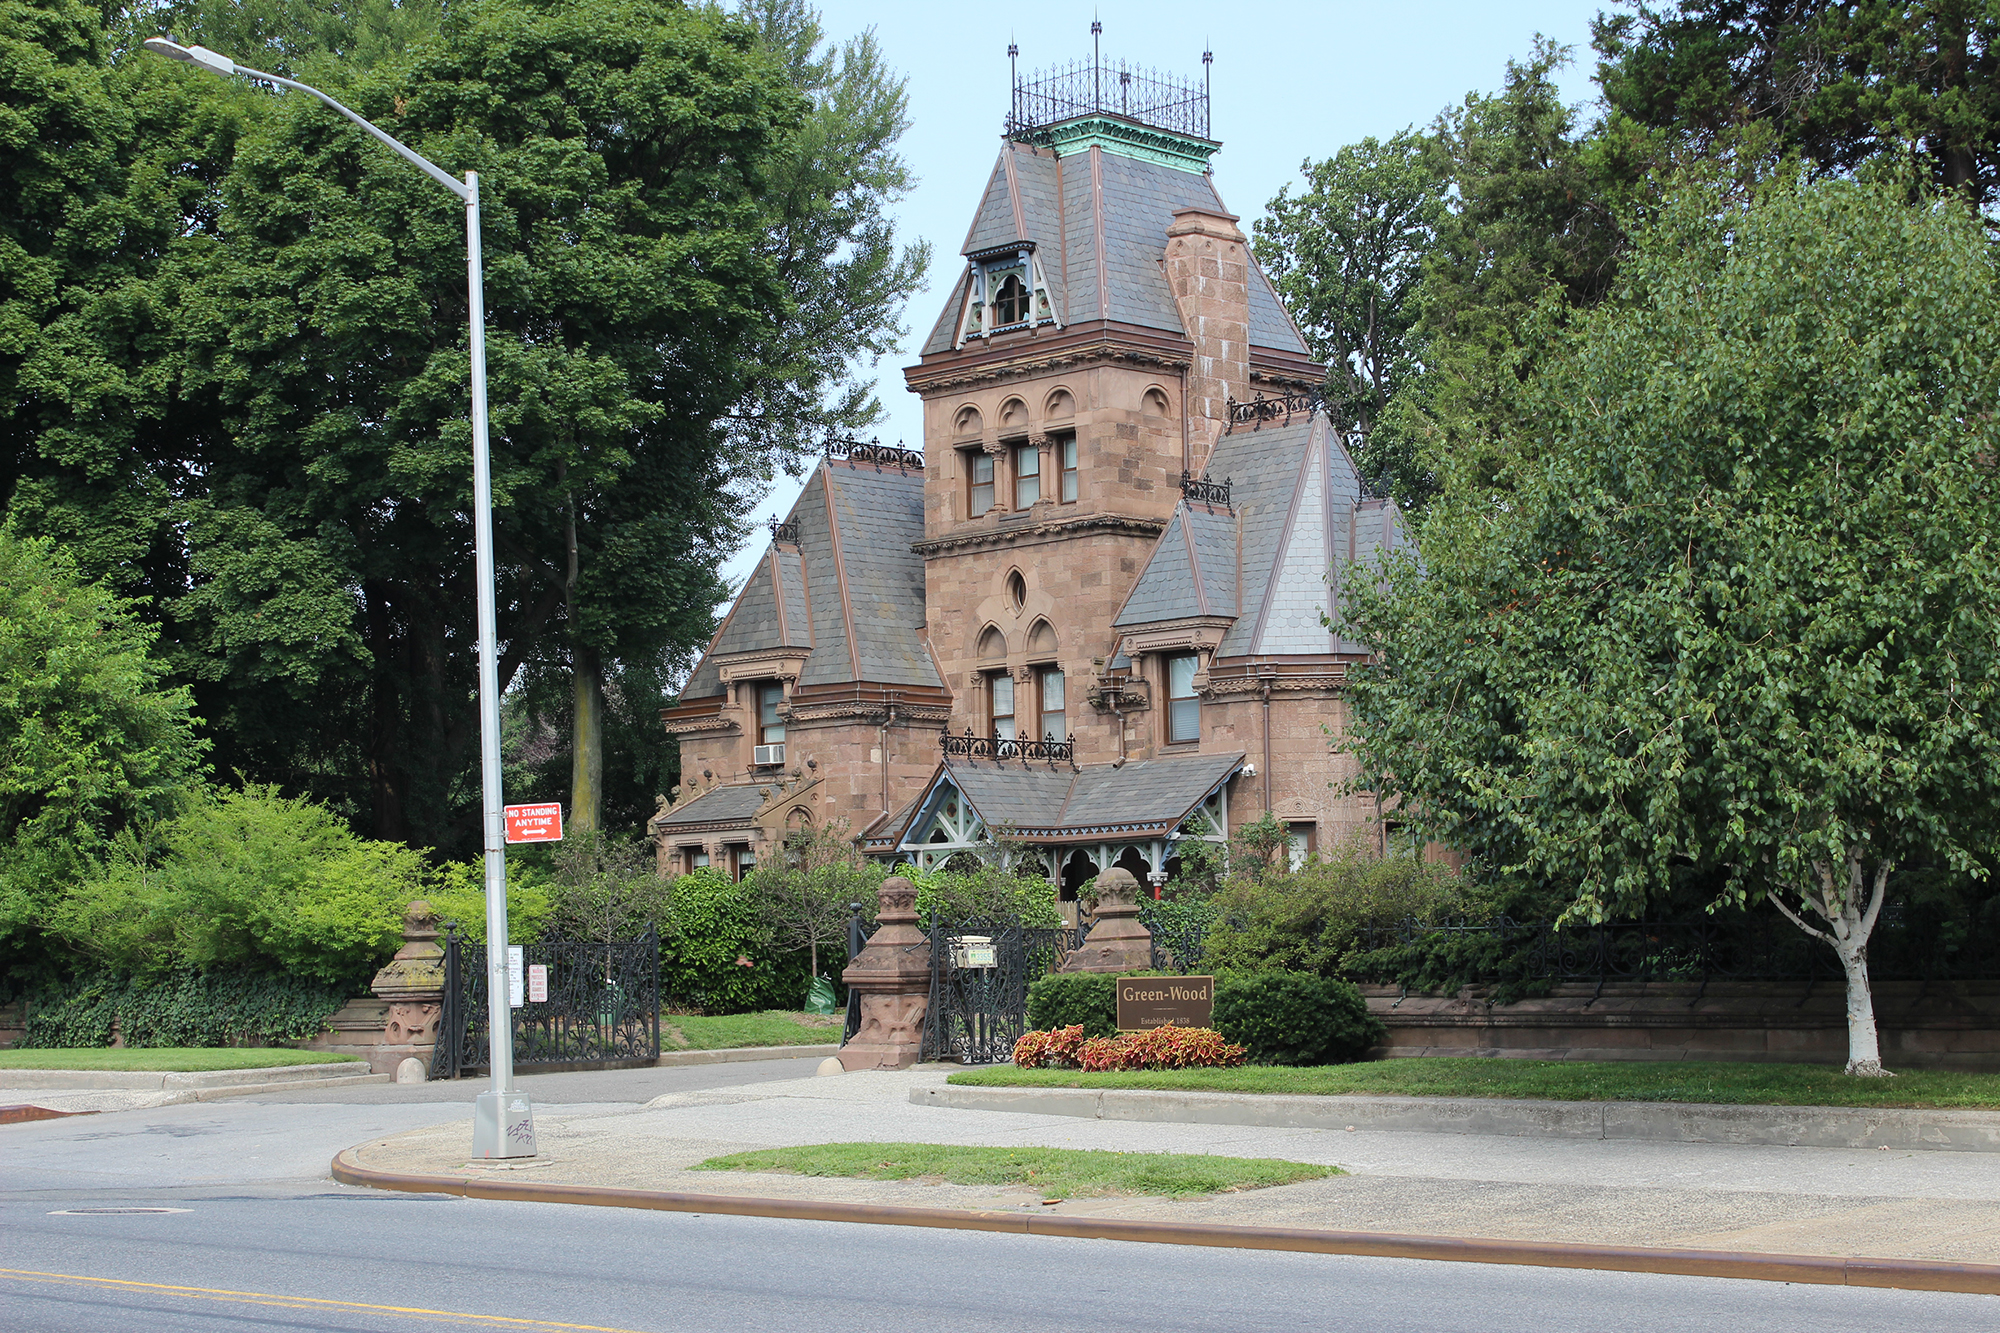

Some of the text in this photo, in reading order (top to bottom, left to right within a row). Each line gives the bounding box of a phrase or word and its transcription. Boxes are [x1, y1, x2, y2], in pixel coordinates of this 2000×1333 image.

[508, 807, 558, 818] NO STANDING
[515, 817, 553, 827] ANYTIME
[976, 952, 992, 961] 3355
[1123, 985, 1208, 1002] Green-Wood
